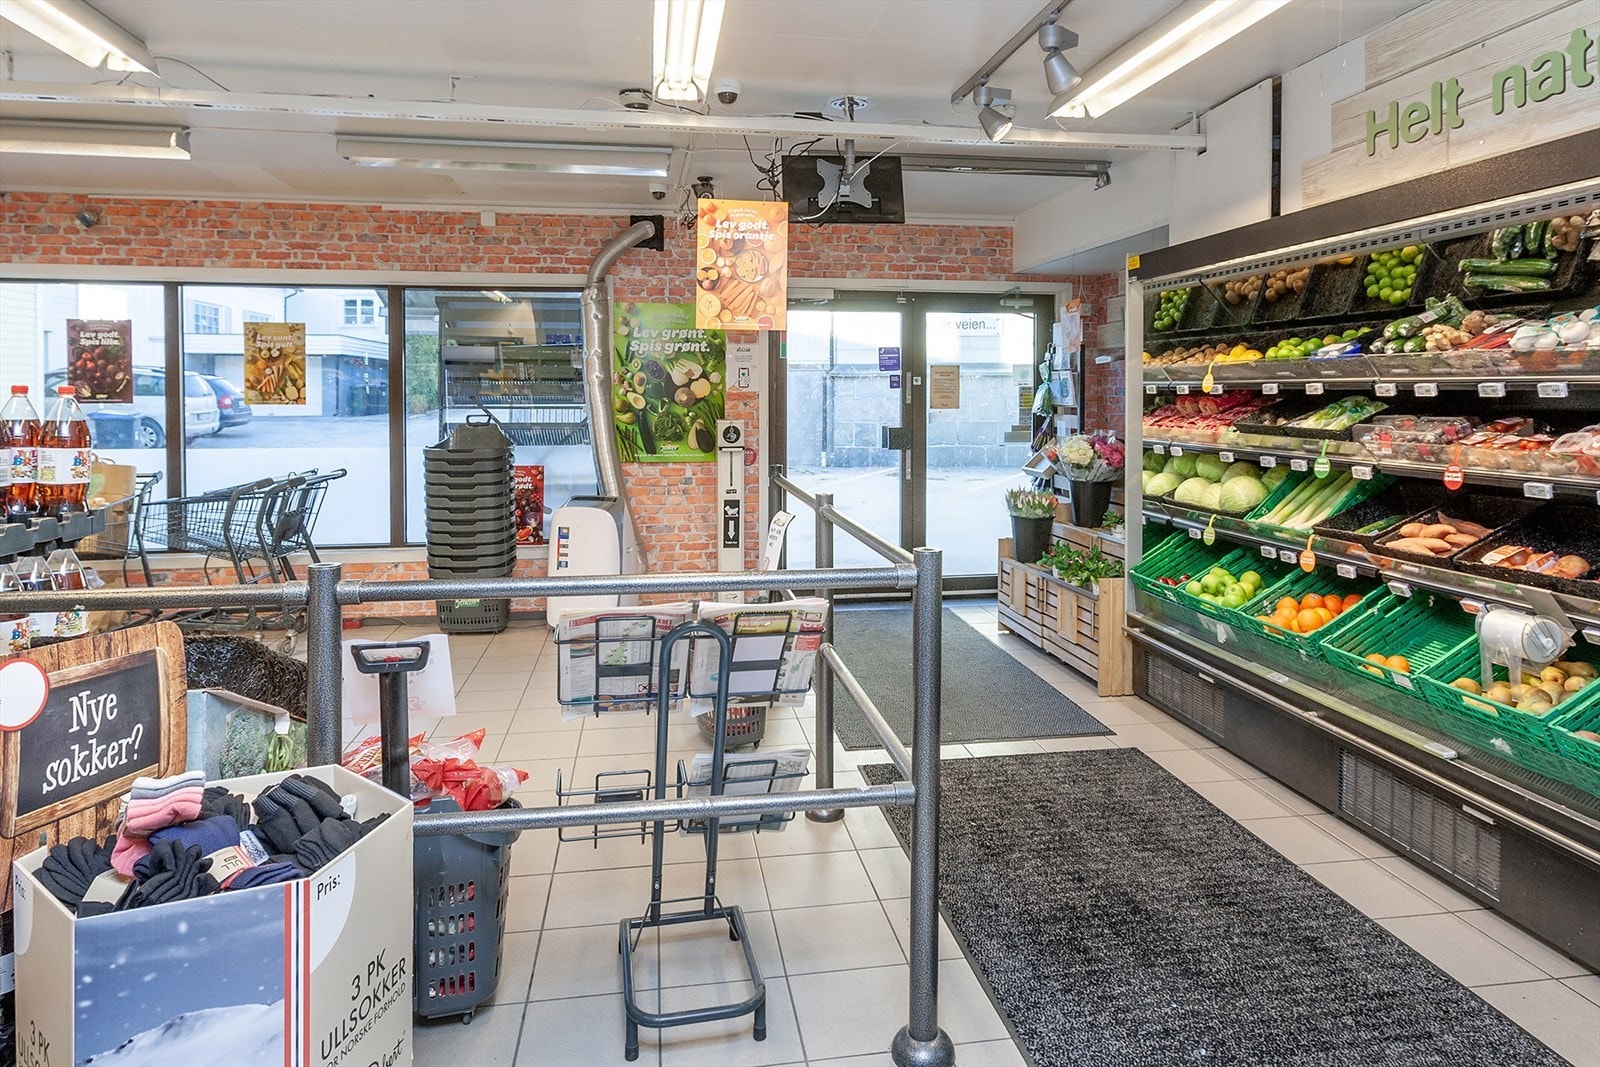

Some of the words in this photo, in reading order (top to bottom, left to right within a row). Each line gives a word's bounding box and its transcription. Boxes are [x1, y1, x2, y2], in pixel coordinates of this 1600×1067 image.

[1365, 77, 1463, 156] Helt
[1491, 27, 1600, 116] nat
[708, 230, 732, 240] Spis
[734, 230, 776, 240] oransje.
[716, 220, 736, 228] Lev
[738, 220, 770, 231] godt.
[630, 340, 662, 353] Spis
[664, 341, 710, 354] grønt.
[633, 327, 660, 338] Lev
[662, 328, 707, 340] grønt.
[955, 320, 996, 330] veien...
[68, 690, 118, 735] Nye
[42, 723, 143, 794] sokker?
[316, 874, 341, 901] Pris:
[351, 974, 361, 1002] 3
[367, 948, 386, 986] PK
[321, 957, 406, 1061] ULLSOKKER
[340, 1018, 374, 1060] NORSKE
[374, 982, 406, 1024] FORHOLD
[30, 1020, 36, 1046] 3
[38, 1031, 50, 1066] PK
